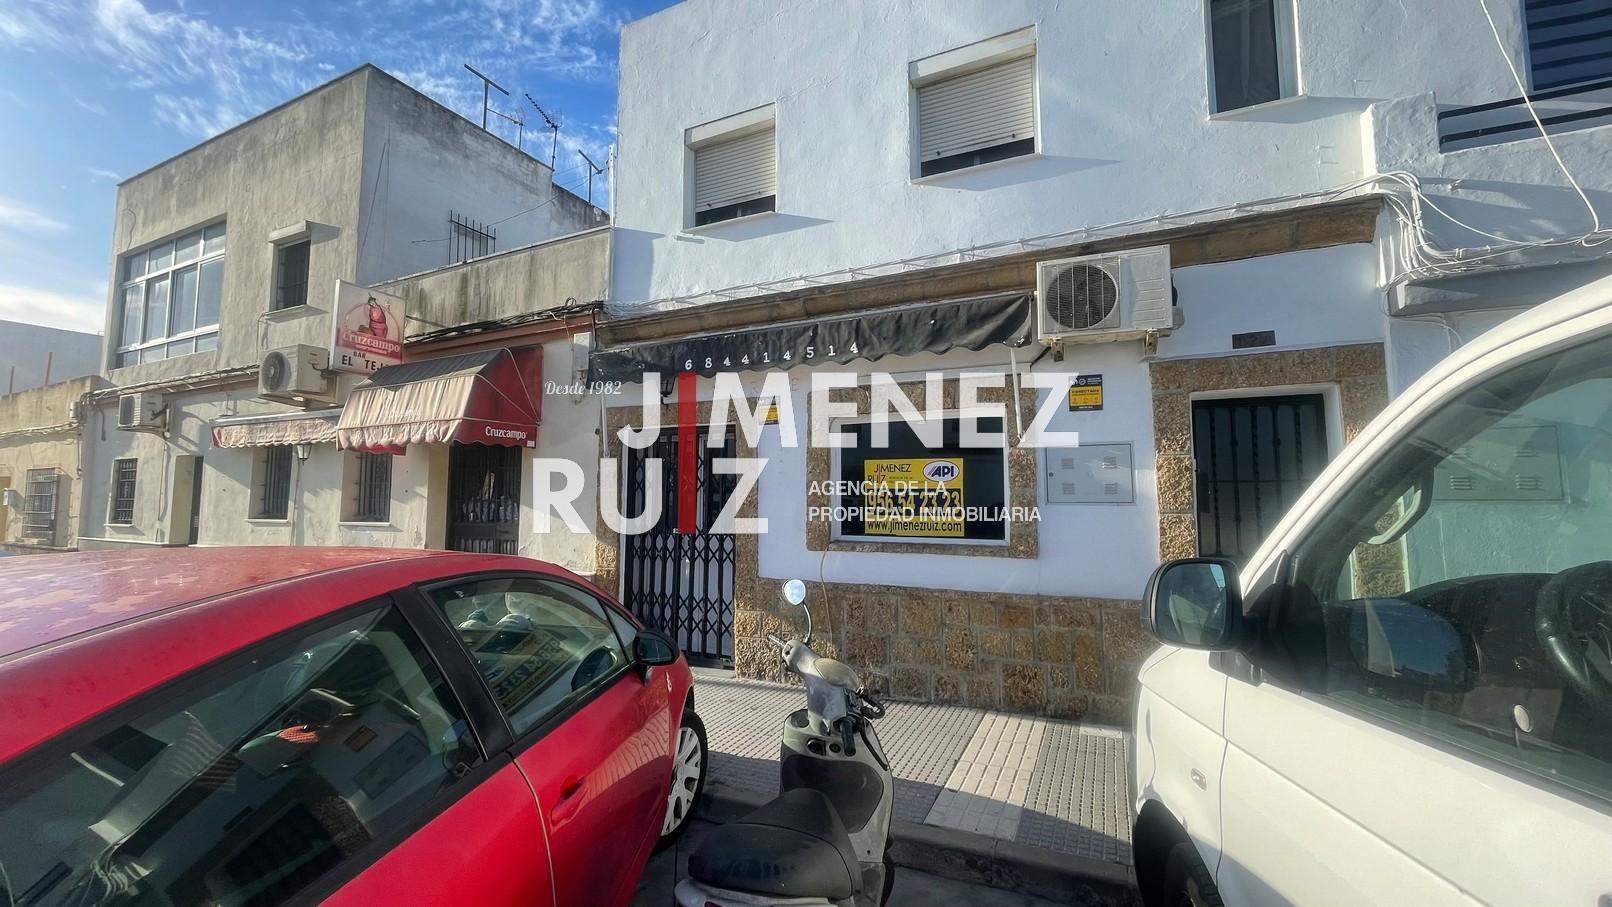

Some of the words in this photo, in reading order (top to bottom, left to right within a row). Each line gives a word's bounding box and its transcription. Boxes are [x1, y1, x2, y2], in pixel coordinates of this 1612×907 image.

[343, 331, 400, 353] Cruzcampo
[341, 354, 353, 367] EL
[364, 359, 389, 371] TEJ
[485, 425, 527, 440] Cruzcampo
[874, 463, 912, 473] JIMENEZ
[931, 465, 955, 478] API
[867, 489, 894, 514] 956
[897, 490, 916, 514] 54
[920, 491, 938, 514] 23
[942, 491, 961, 515] 23
[867, 520, 962, 533] www.jimenezruiz.com
